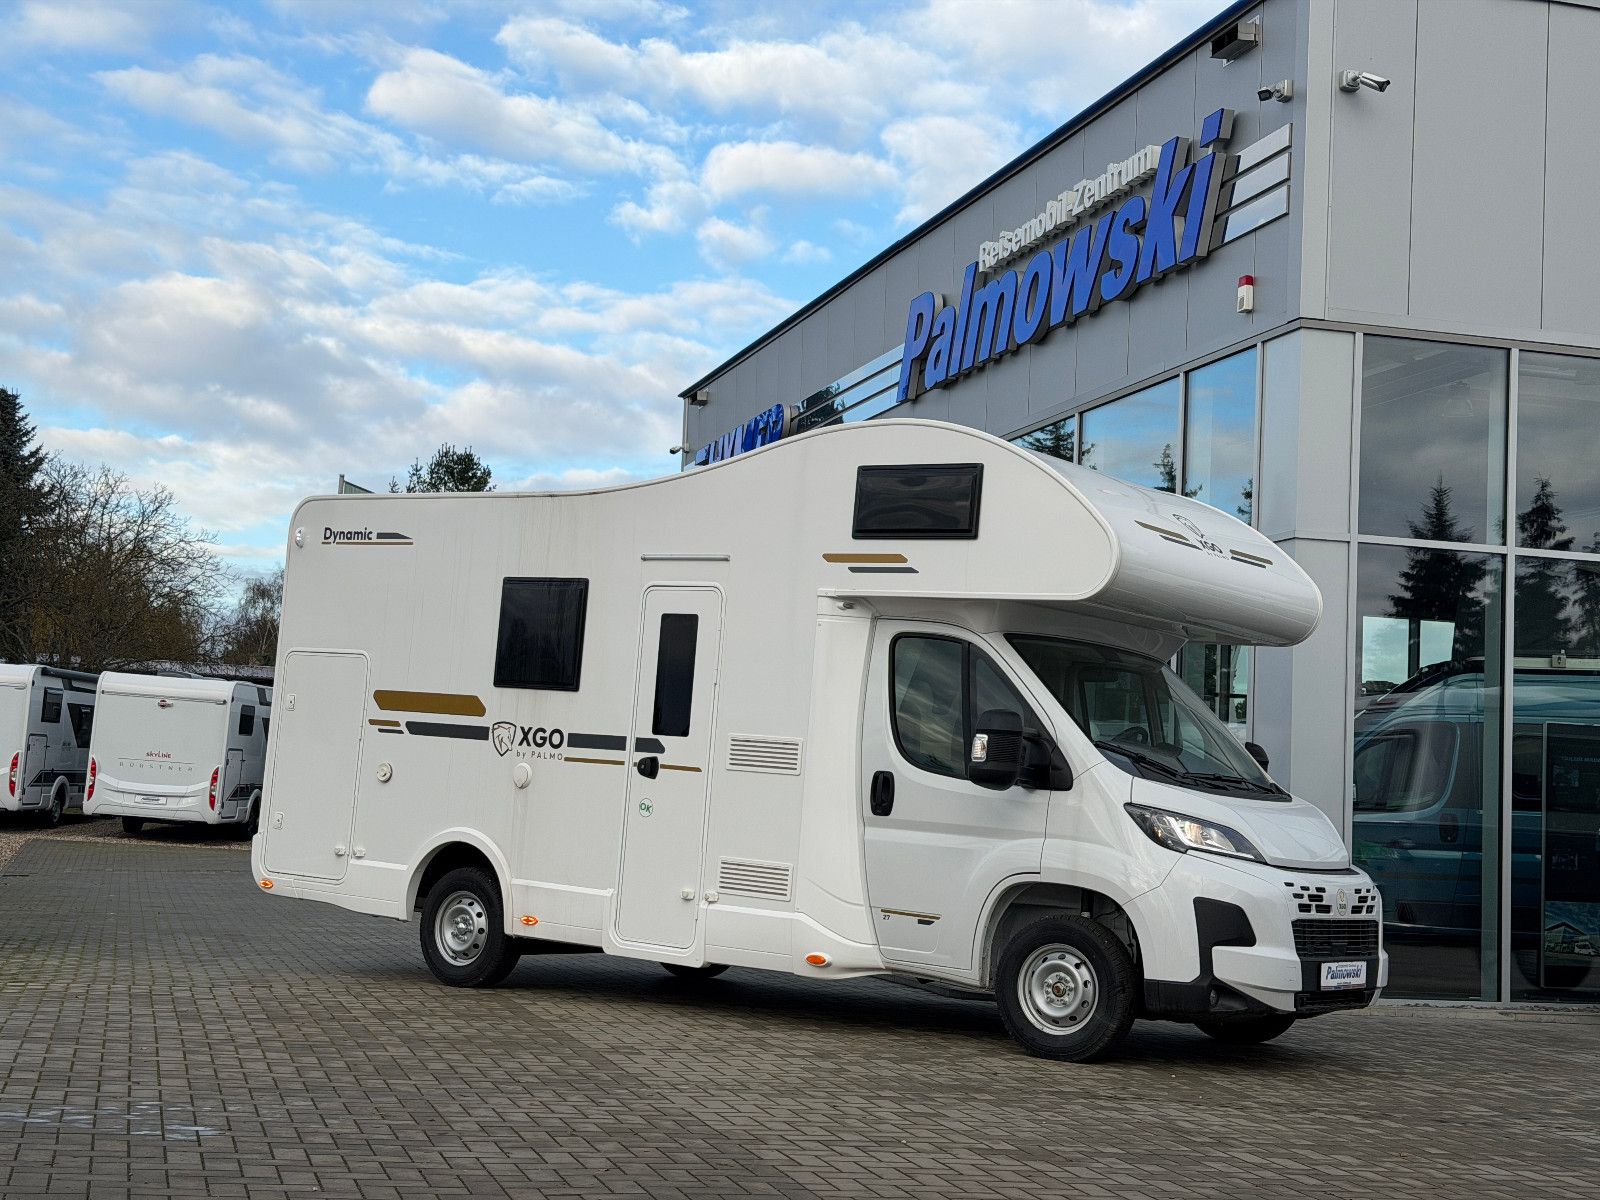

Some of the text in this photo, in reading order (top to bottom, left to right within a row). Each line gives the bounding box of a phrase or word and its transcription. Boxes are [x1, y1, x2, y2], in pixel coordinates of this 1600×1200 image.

[978, 145, 1161, 272] Reisemobil-Zentrum
[896, 108, 1232, 401] Palmowski
[323, 527, 373, 543] Dynamic
[518, 726, 565, 749] XGO
[516, 750, 564, 761] by PALMO
[640, 802, 652, 814] OK
